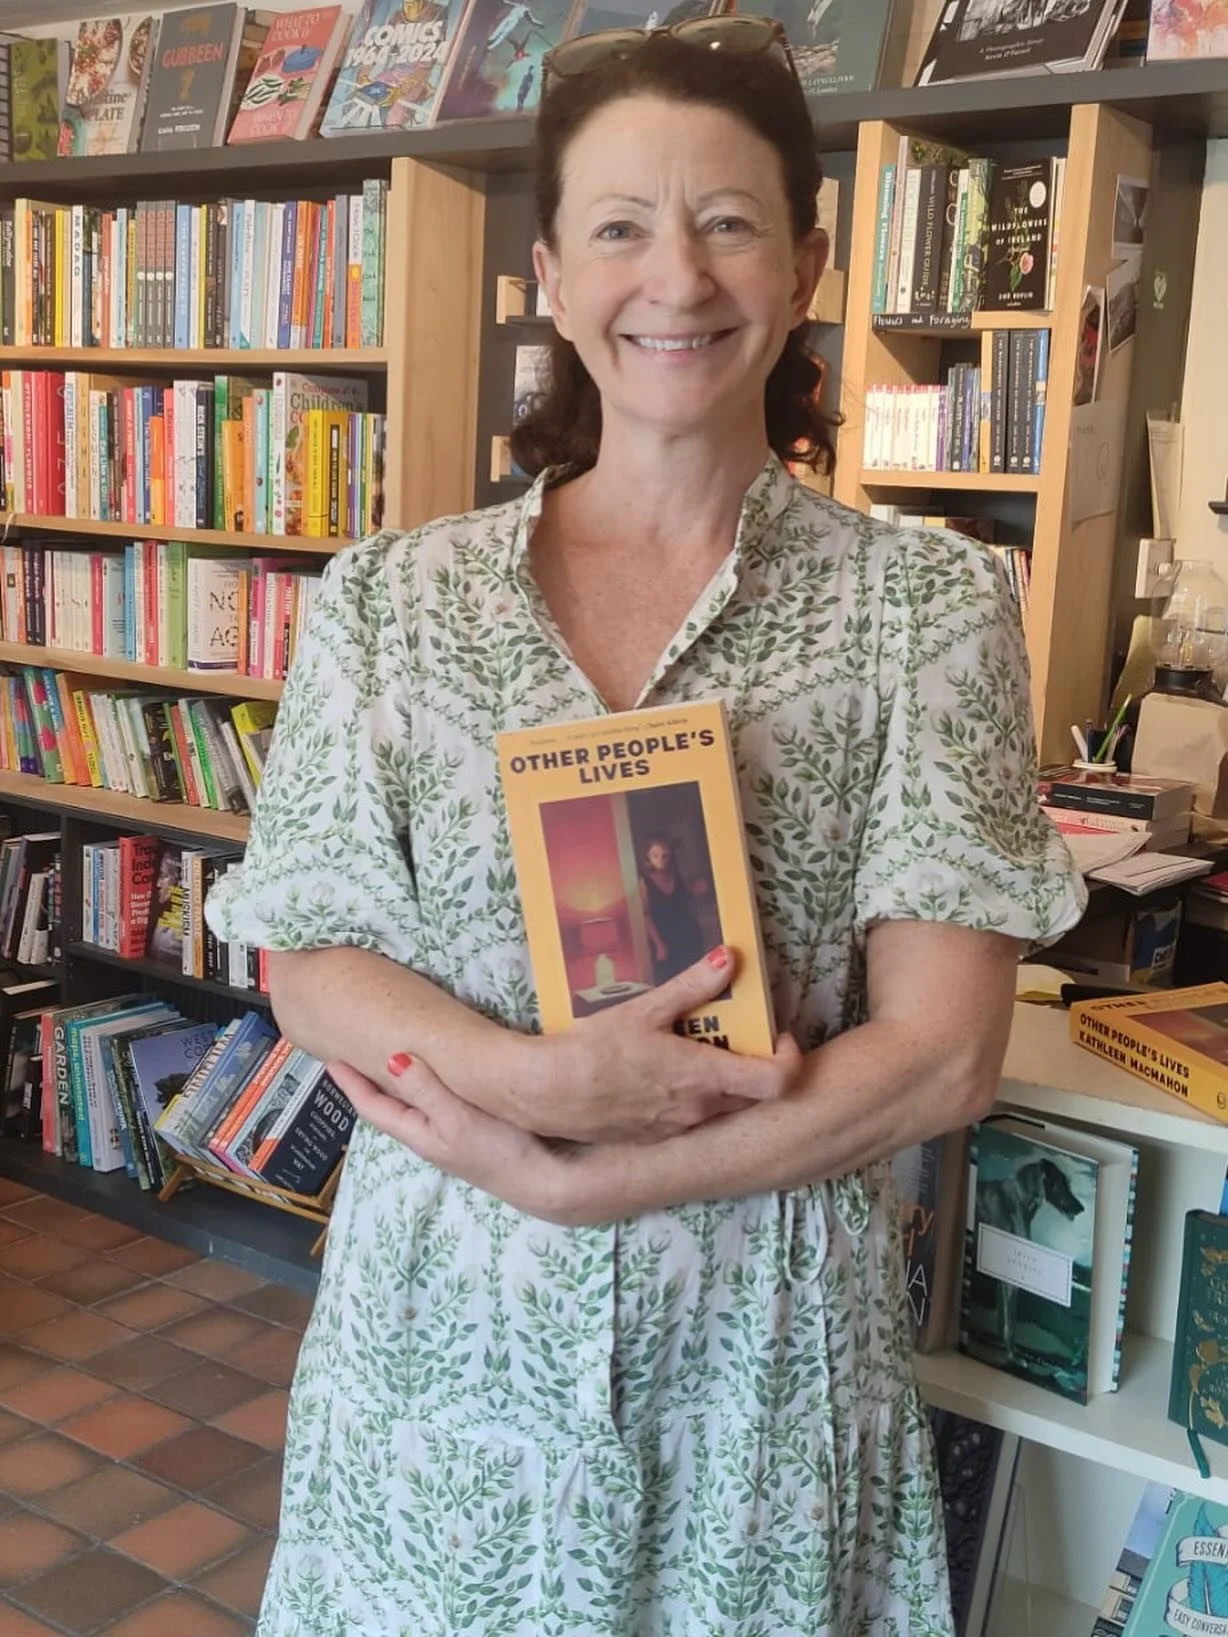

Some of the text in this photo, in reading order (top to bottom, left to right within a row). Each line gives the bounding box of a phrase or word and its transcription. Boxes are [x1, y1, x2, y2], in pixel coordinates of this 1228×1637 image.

[364, 20, 444, 47] COMICS
[162, 41, 224, 69] GUBBEEN
[345, 40, 450, 68] 1964-2024
[926, 196, 935, 220] WILD
[991, 218, 1048, 232] WILDFLOWERS
[1008, 233, 1043, 244] IRELAND
[924, 222, 933, 257] FLOWER
[929, 314, 970, 329] Foraging
[210, 591, 239, 611] NO
[510, 748, 590, 774] OTHER
[597, 729, 715, 762] PEOPLE'S
[579, 759, 651, 784] LIVES
[1080, 1013, 1191, 1079] OTHER PEOPLE'S LIVES
[53, 1026, 70, 1106] GARDEN
[1079, 1031, 1189, 1097] KATHLEEN MACMAHON
[314, 1090, 350, 1132] WOOD
[1173, 1608, 1190, 1626] EASY
